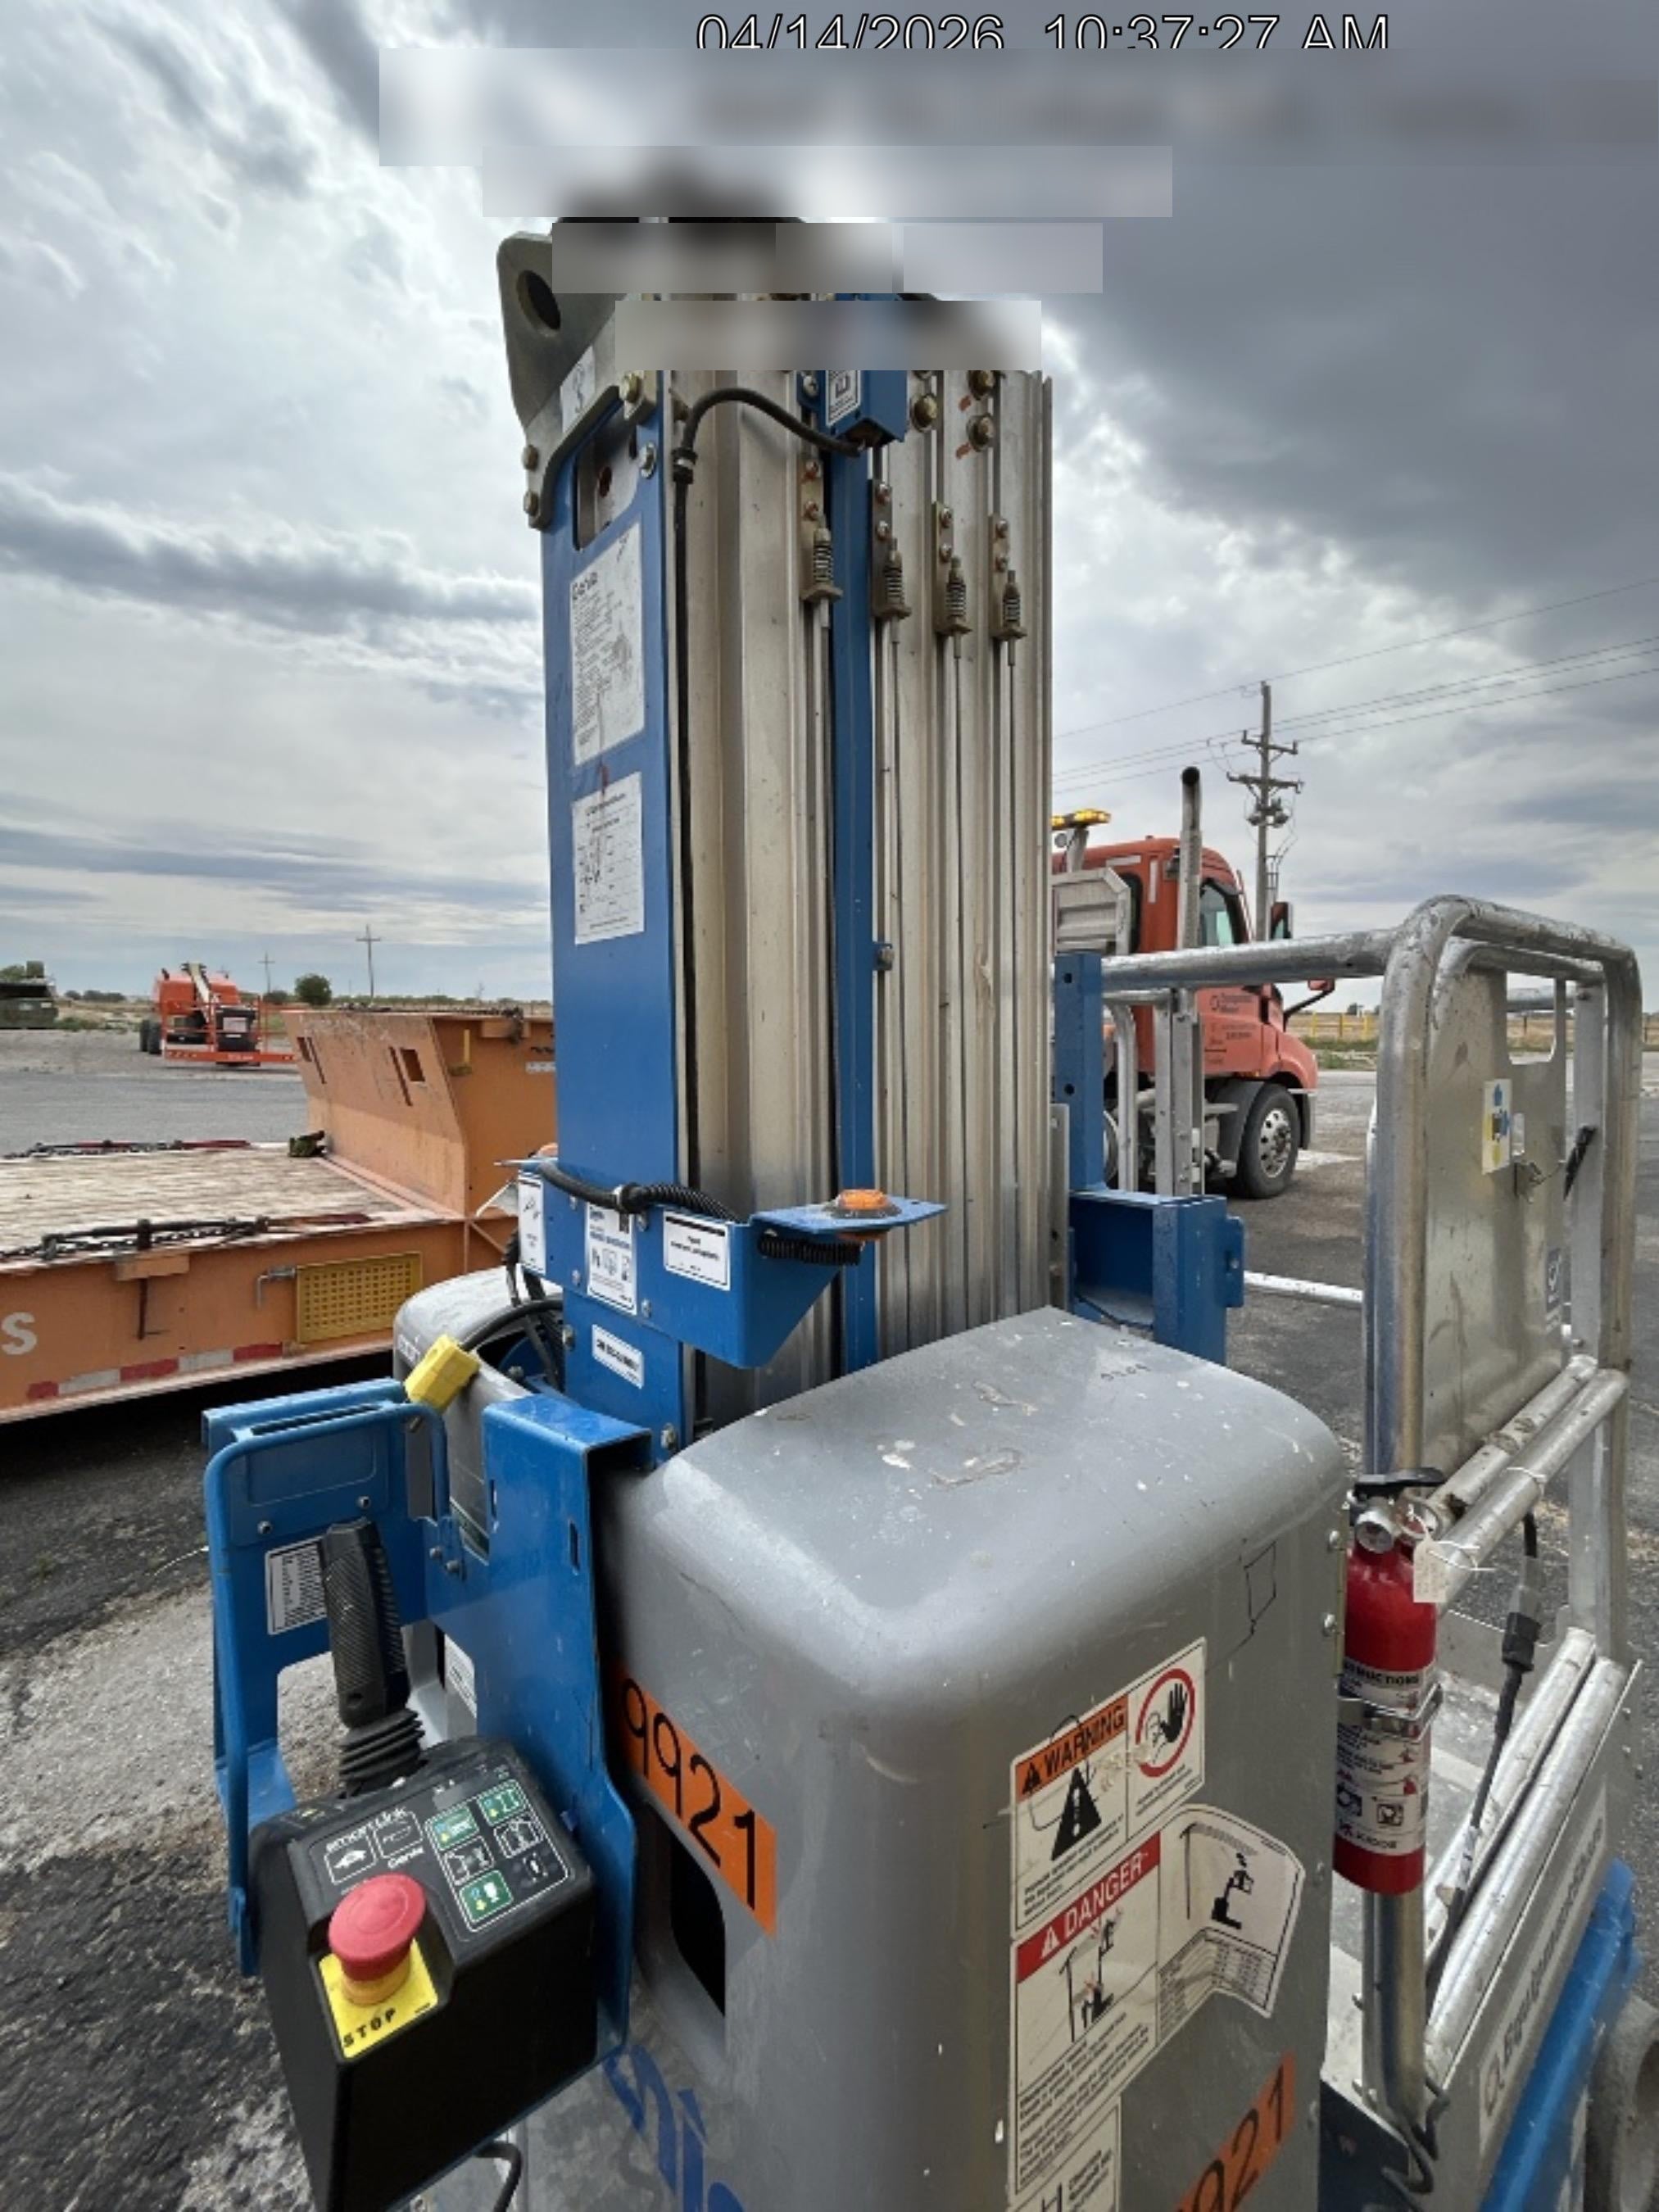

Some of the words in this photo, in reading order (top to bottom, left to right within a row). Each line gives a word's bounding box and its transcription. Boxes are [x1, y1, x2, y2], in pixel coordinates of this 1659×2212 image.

[1, 1312, 37, 1355] S
[1044, 1704, 1125, 1778] WARNING
[623, 1678, 756, 1911] 9921
[1065, 1852, 1142, 1939] DANGER
[343, 2006, 396, 2047] STOP
